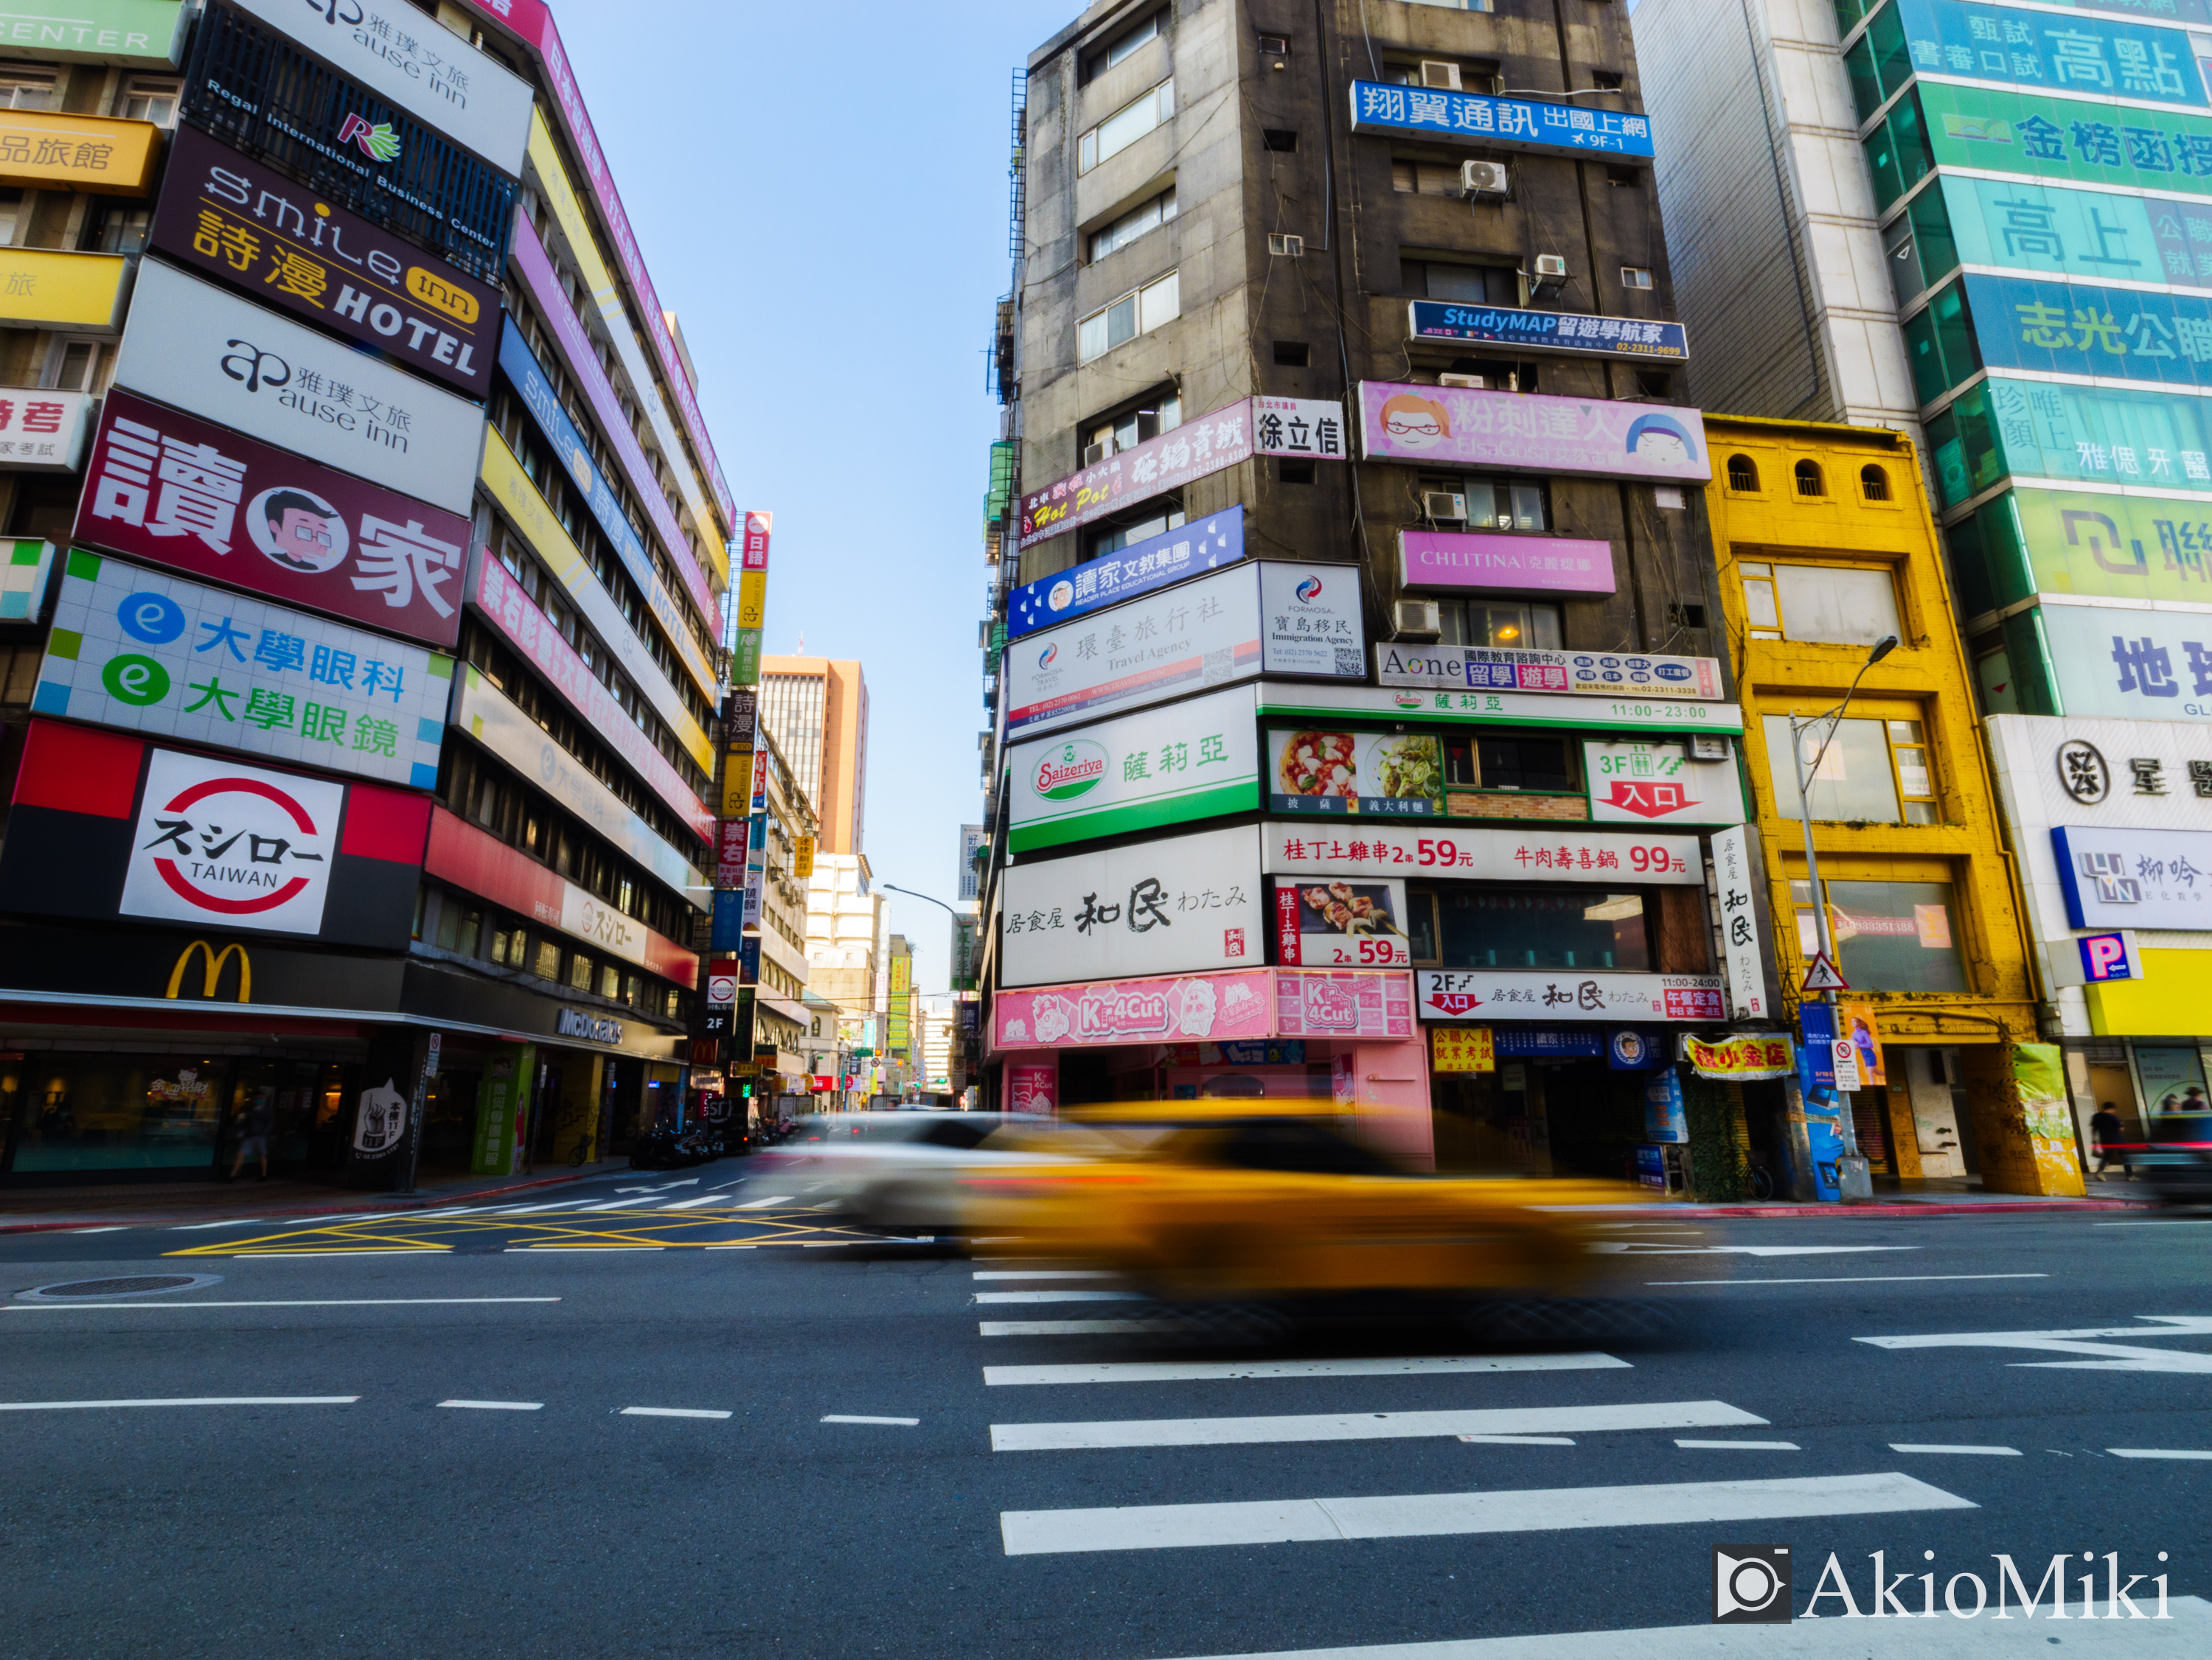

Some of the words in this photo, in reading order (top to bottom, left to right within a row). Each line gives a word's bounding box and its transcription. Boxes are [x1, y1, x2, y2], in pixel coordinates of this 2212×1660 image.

[0, 22, 149, 49] ENTER
[1969, 15, 2034, 46] 甄試
[352, 27, 420, 79] ause
[428, 70, 467, 110] inn
[369, 12, 470, 94] 雅璞文旅
[1910, 38, 2042, 80] 書審口試
[2044, 28, 2187, 97] 高點
[1363, 86, 1539, 138] 翔翼通訊
[1543, 107, 1648, 139] 出國上網
[0, 135, 114, 170] 品旅館
[1589, 133, 1624, 151] 9F-1
[207, 78, 258, 115] Regal
[267, 113, 369, 178] International
[377, 174, 443, 220] Business
[451, 217, 496, 250] Center
[1993, 198, 2142, 268] 高上
[192, 209, 328, 310] 詩漫
[333, 284, 476, 377] HOTEL
[1443, 307, 1557, 334] StudyMAP
[1557, 315, 1664, 343] 留遊學航家
[2014, 301, 2212, 363] 志光公職
[1617, 341, 1681, 356] 02-2311-9699
[295, 366, 411, 434] 雅璞文旅
[1257, 400, 1297, 411] 台北市議員
[279, 386, 358, 433] ause
[366, 422, 409, 455] inn
[1257, 412, 1341, 453] 徐立信
[1453, 394, 1622, 444] 粉刺達人
[1131, 416, 1245, 484] 砸鍋賣鐵
[93, 415, 248, 556] 讀
[349, 512, 462, 620] 家
[1034, 502, 1068, 528] Hot
[1076, 484, 1110, 510] Pot
[747, 536, 764, 565] 日語
[1419, 550, 1522, 569] CHLITINA
[1075, 540, 1191, 601] 讀家文教集團
[1075, 594, 1099, 607] READER
[1100, 589, 1121, 601] PLACE
[1121, 572, 1166, 595] EDUCATIONAL
[1166, 561, 1191, 579] GROUP
[653, 585, 686, 652] HOTEL
[1274, 615, 1352, 635] 寶島移民
[1288, 605, 1332, 615] FORMOSA
[1076, 596, 1224, 663] 環臺旅行社
[1272, 632, 1324, 644] Immigration
[1324, 635, 1354, 646] Agency
[194, 616, 405, 704] 大學眼科
[1107, 649, 1145, 673] Travel
[1147, 635, 1192, 663] Agency
[1273, 647, 1283, 655] Tel:
[1284, 649, 1297, 657] (02)
[1382, 649, 1462, 677] Aone
[1464, 649, 1567, 666] 國際教育諮詢中心
[1031, 667, 1063, 682] FORMOSA
[1036, 675, 1060, 687] TRAVEL
[1469, 664, 1513, 686] 留學
[1521, 666, 1565, 689] 遊學
[1604, 672, 1621, 681] 日本
[1642, 686, 1697, 694] 02-2311-3338
[1042, 702, 1054, 711] (02)
[1087, 691, 1120, 707] Registration
[1121, 684, 1151, 697] Certificate
[1434, 694, 1504, 711] 薩莉亞
[184, 676, 400, 759] 大學眼鏡
[731, 694, 754, 734] 詩漫
[1611, 704, 1707, 719] 11:00-23:00
[1037, 758, 1103, 789] Saizeriya
[1123, 733, 1229, 783] 薩莉亞
[1599, 756, 1627, 775] 3F
[1286, 797, 1332, 810] 披薩
[1368, 798, 1425, 814] 義大利麵
[1621, 784, 1677, 808] 入口
[142, 817, 325, 865] スシロー
[722, 823, 745, 863] 崇右
[1282, 838, 1391, 862] 桂丁土雞串
[1392, 846, 1413, 864] 2串
[1418, 838, 1474, 868] 59元
[1513, 845, 1619, 871] 牛肉壽喜鍋
[1629, 845, 1686, 873] 99元
[1724, 838, 1739, 881] 居食屋
[2135, 853, 2212, 889] 柳吟
[189, 862, 279, 889] TAIWAN
[720, 874, 744, 885] 大學
[1006, 907, 1065, 935] 居食屋
[1074, 876, 1171, 936] 和民
[1178, 886, 1248, 913] わたみ
[1725, 887, 1753, 946] 和民
[592, 910, 633, 947] スシロー
[1279, 890, 1298, 963] 桂丁土雞串
[1332, 949, 1352, 963] 2串
[1359, 939, 1408, 964] 59元
[2087, 937, 2123, 979] P
[1430, 974, 1455, 991] 2F
[1661, 977, 1720, 988] 11:00-24:00
[1739, 954, 1754, 993] わたみ
[1440, 994, 1470, 1011] 入口
[1490, 988, 1537, 1003] 居食屋
[1541, 980, 1606, 1011] 和民
[1608, 989, 1649, 1004] わたみ
[1666, 991, 1720, 1007] 午餐定食
[557, 1008, 625, 1045] McDonald's
[706, 1017, 724, 1030] 2F
[1308, 1006, 1352, 1022] 4Cut
[1669, 1007, 1684, 1016] 平日
[1434, 1028, 1491, 1045] 公職人員
[1434, 1045, 1493, 1061] 就業考試
